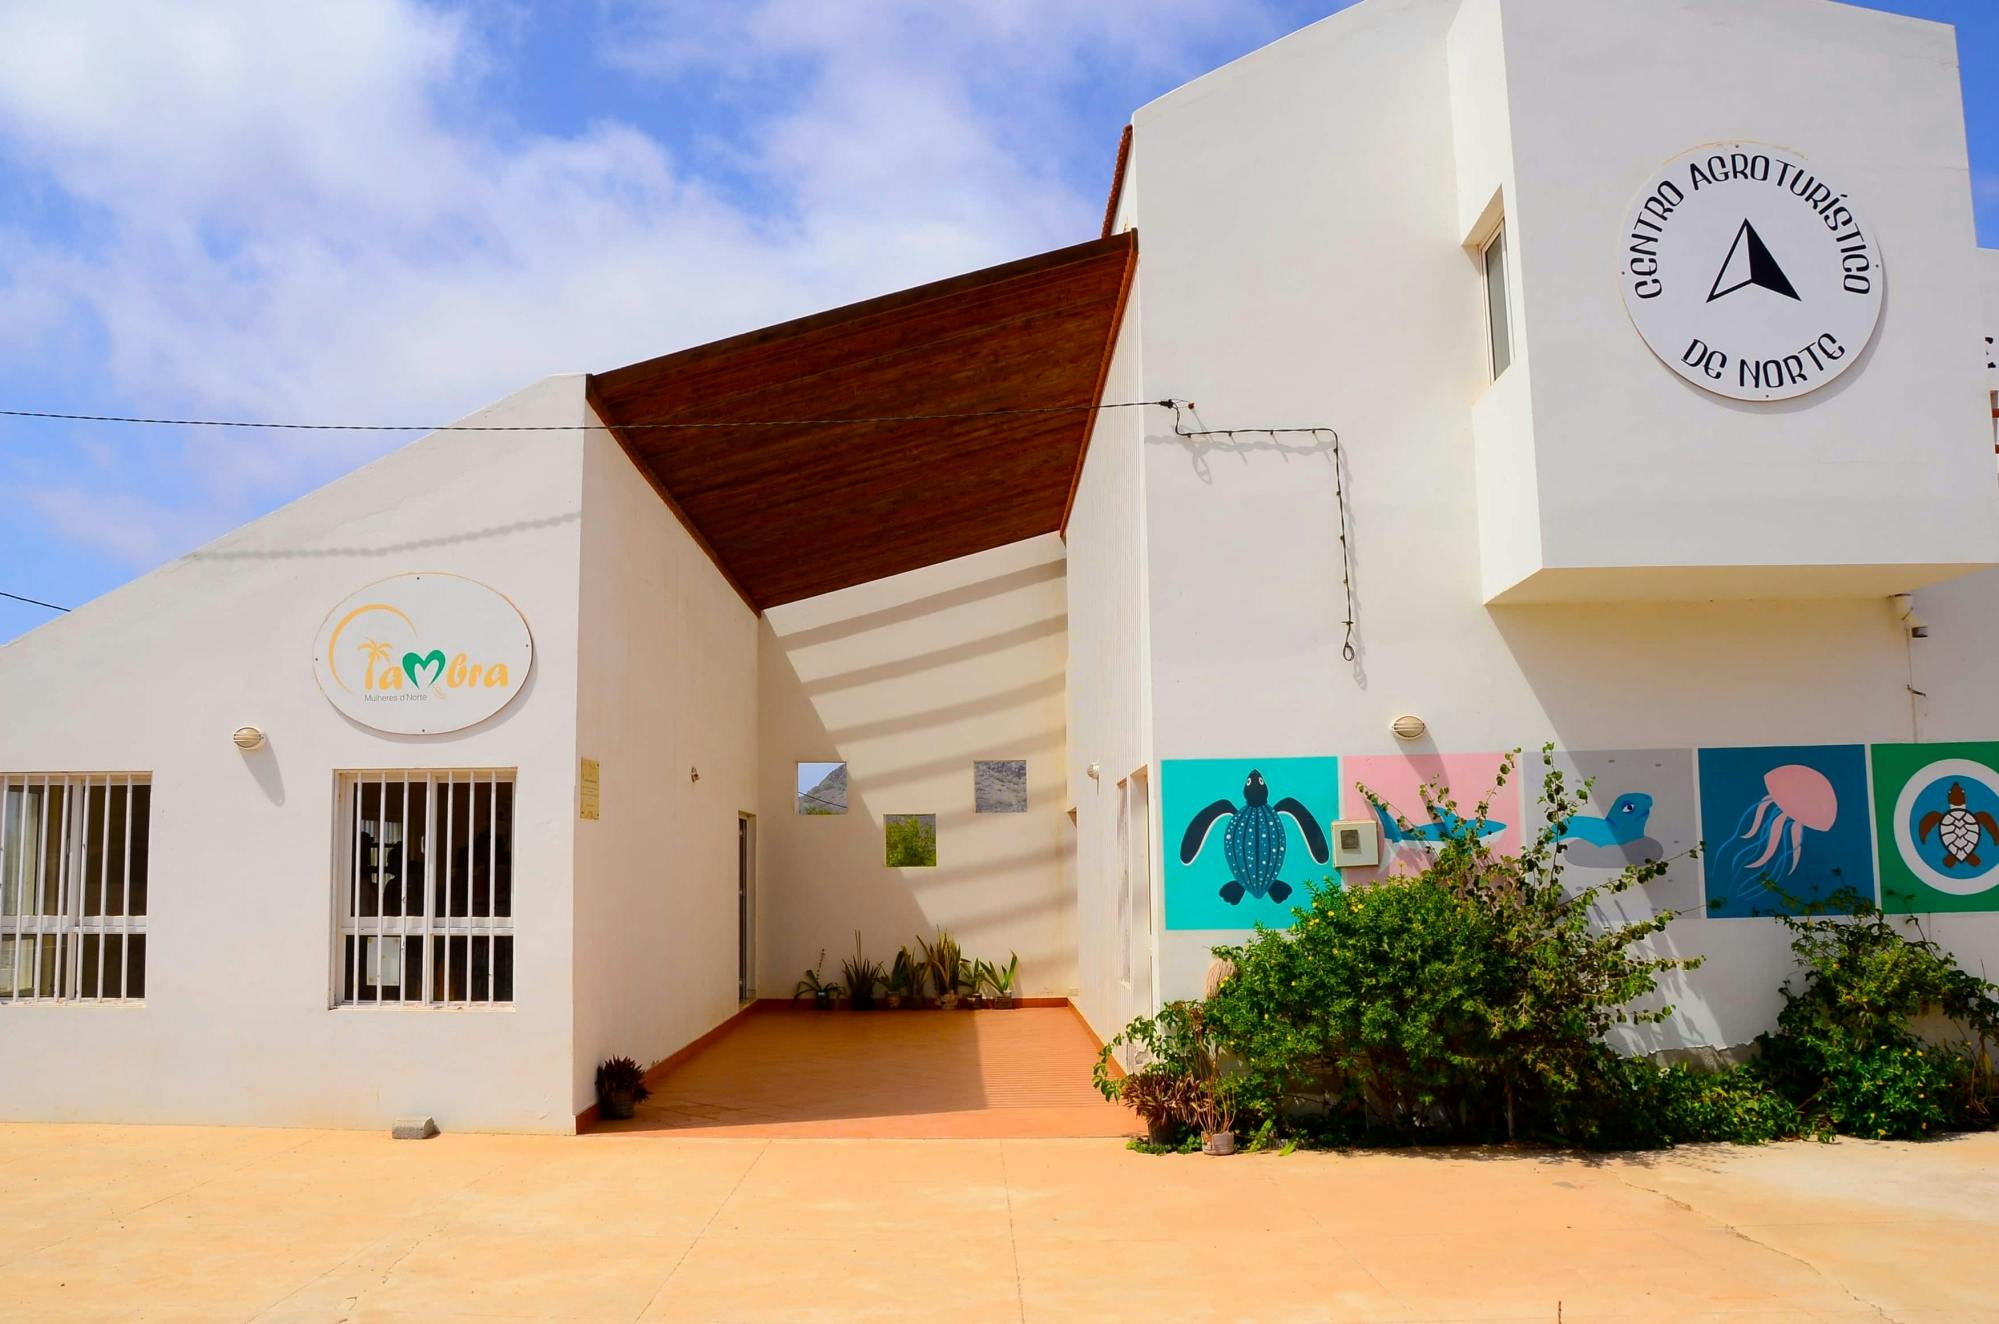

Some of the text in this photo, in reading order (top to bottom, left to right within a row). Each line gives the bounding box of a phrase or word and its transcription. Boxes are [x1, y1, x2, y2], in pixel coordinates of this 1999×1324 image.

[1629, 180, 1685, 299] CENTRO
[1681, 333, 1845, 388] DE NORTE
[364, 694, 398, 702] Mulheres
